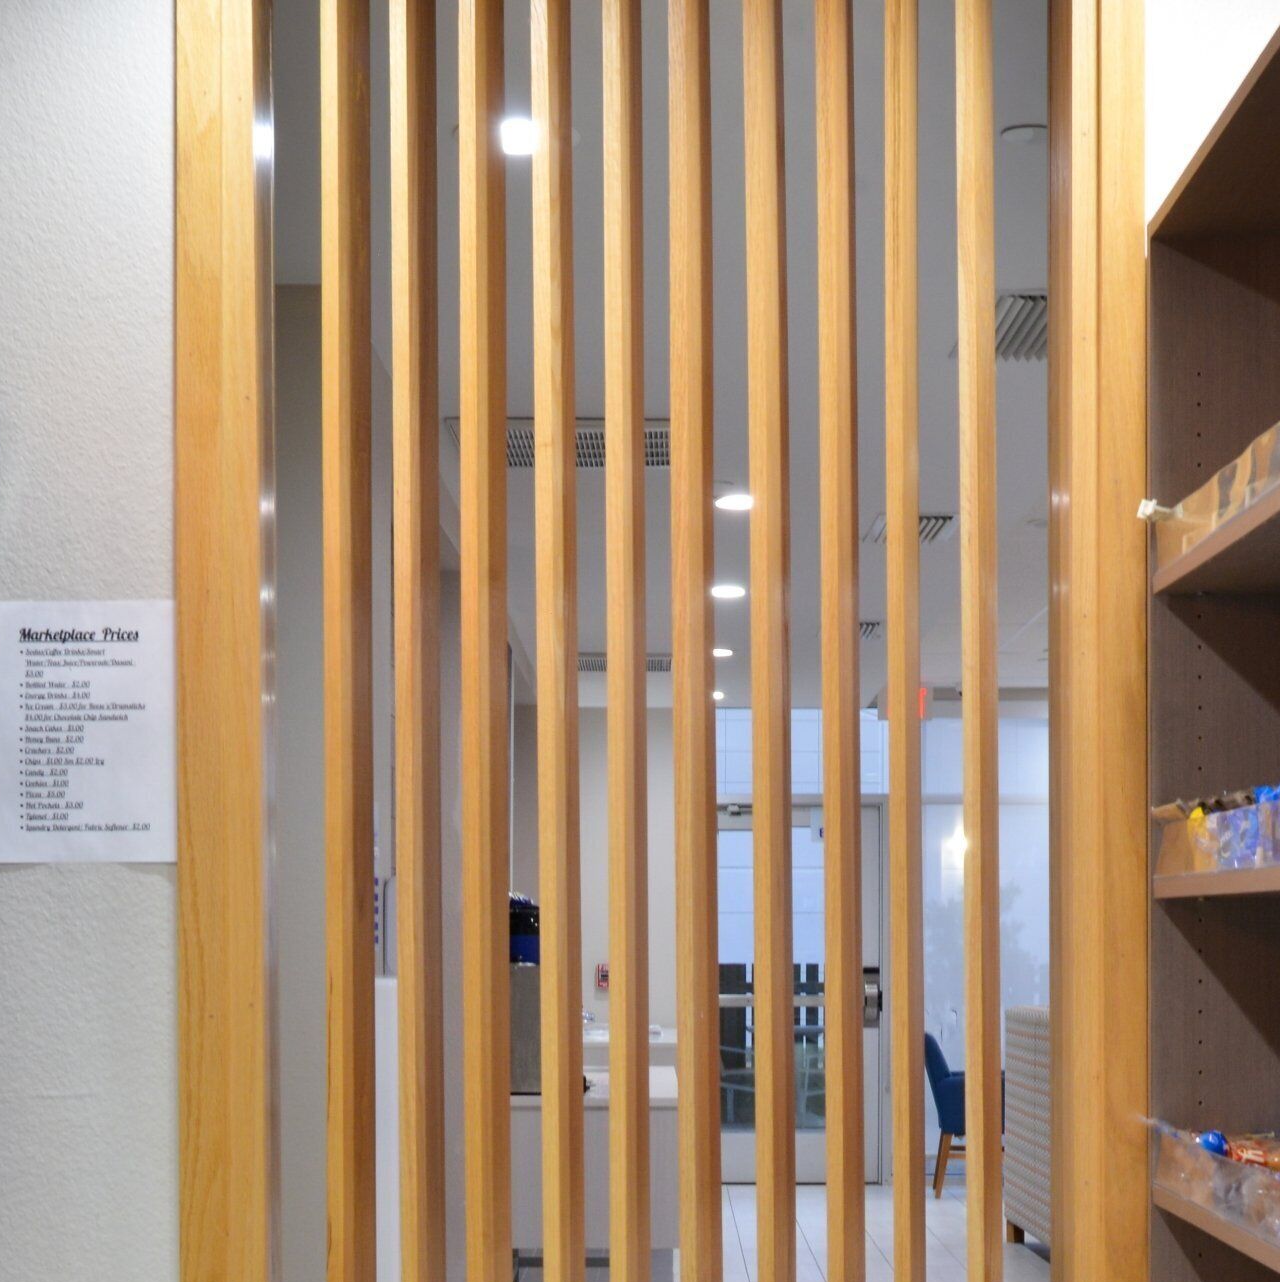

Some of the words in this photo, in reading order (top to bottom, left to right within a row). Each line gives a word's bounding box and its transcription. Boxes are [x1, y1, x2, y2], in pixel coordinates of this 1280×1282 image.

[18, 627, 96, 644] Marketplace
[101, 627, 140, 642] Prices
[71, 680, 91, 688] $2.00
[56, 746, 74, 755] $2.00
[50, 768, 68, 776] $2.00
